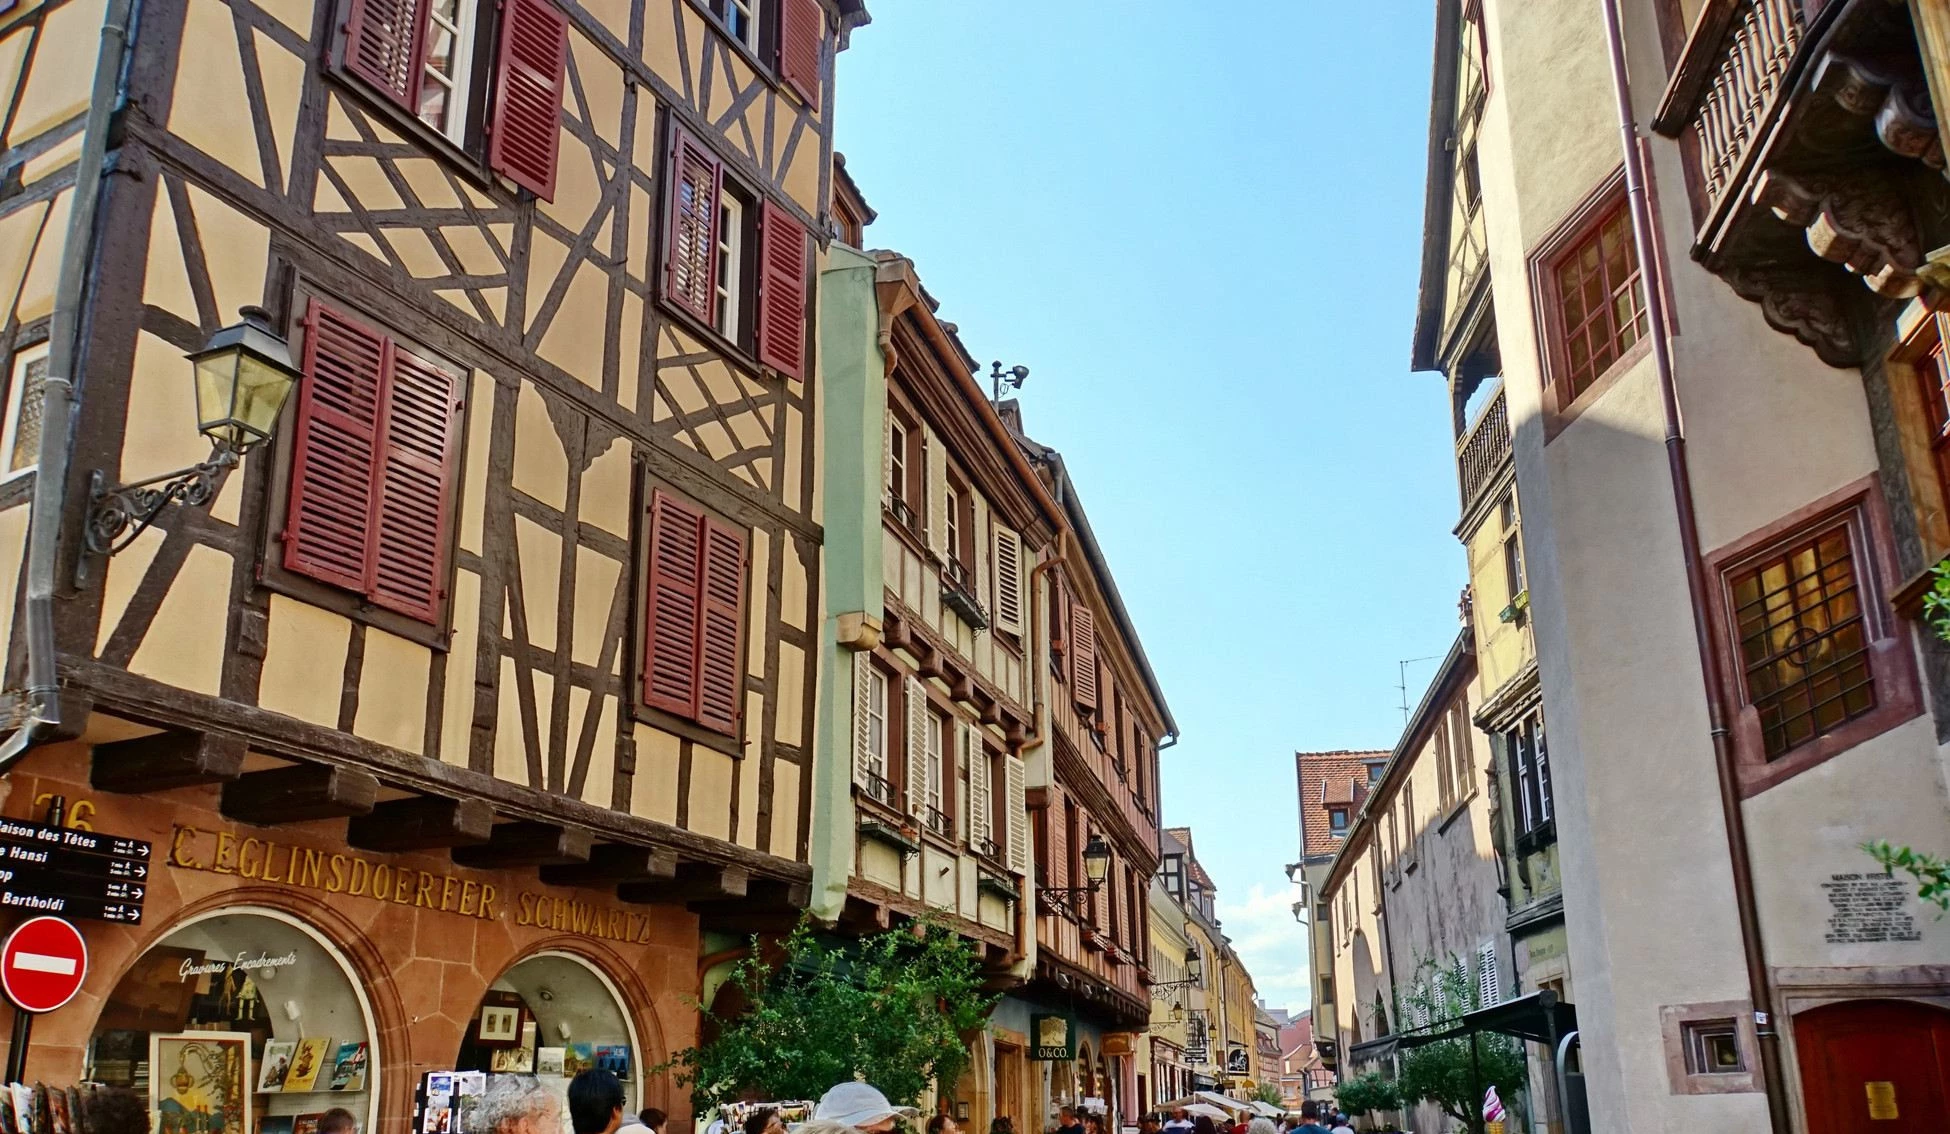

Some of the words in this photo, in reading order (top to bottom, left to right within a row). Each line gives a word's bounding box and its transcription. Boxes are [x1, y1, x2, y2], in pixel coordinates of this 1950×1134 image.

[37, 828, 60, 842] des
[63, 832, 96, 848] Têtes
[9, 846, 48, 863] Hansi
[173, 825, 203, 869] C.
[213, 831, 496, 921] EGLINSDOERFER
[517, 891, 650, 945] SCHWARTZ
[2, 891, 64, 911] Bartholdi
[179, 957, 226, 983] Gravures
[232, 951, 296, 970] Encadrements
[1038, 1047, 1069, 1059] O&CO.
